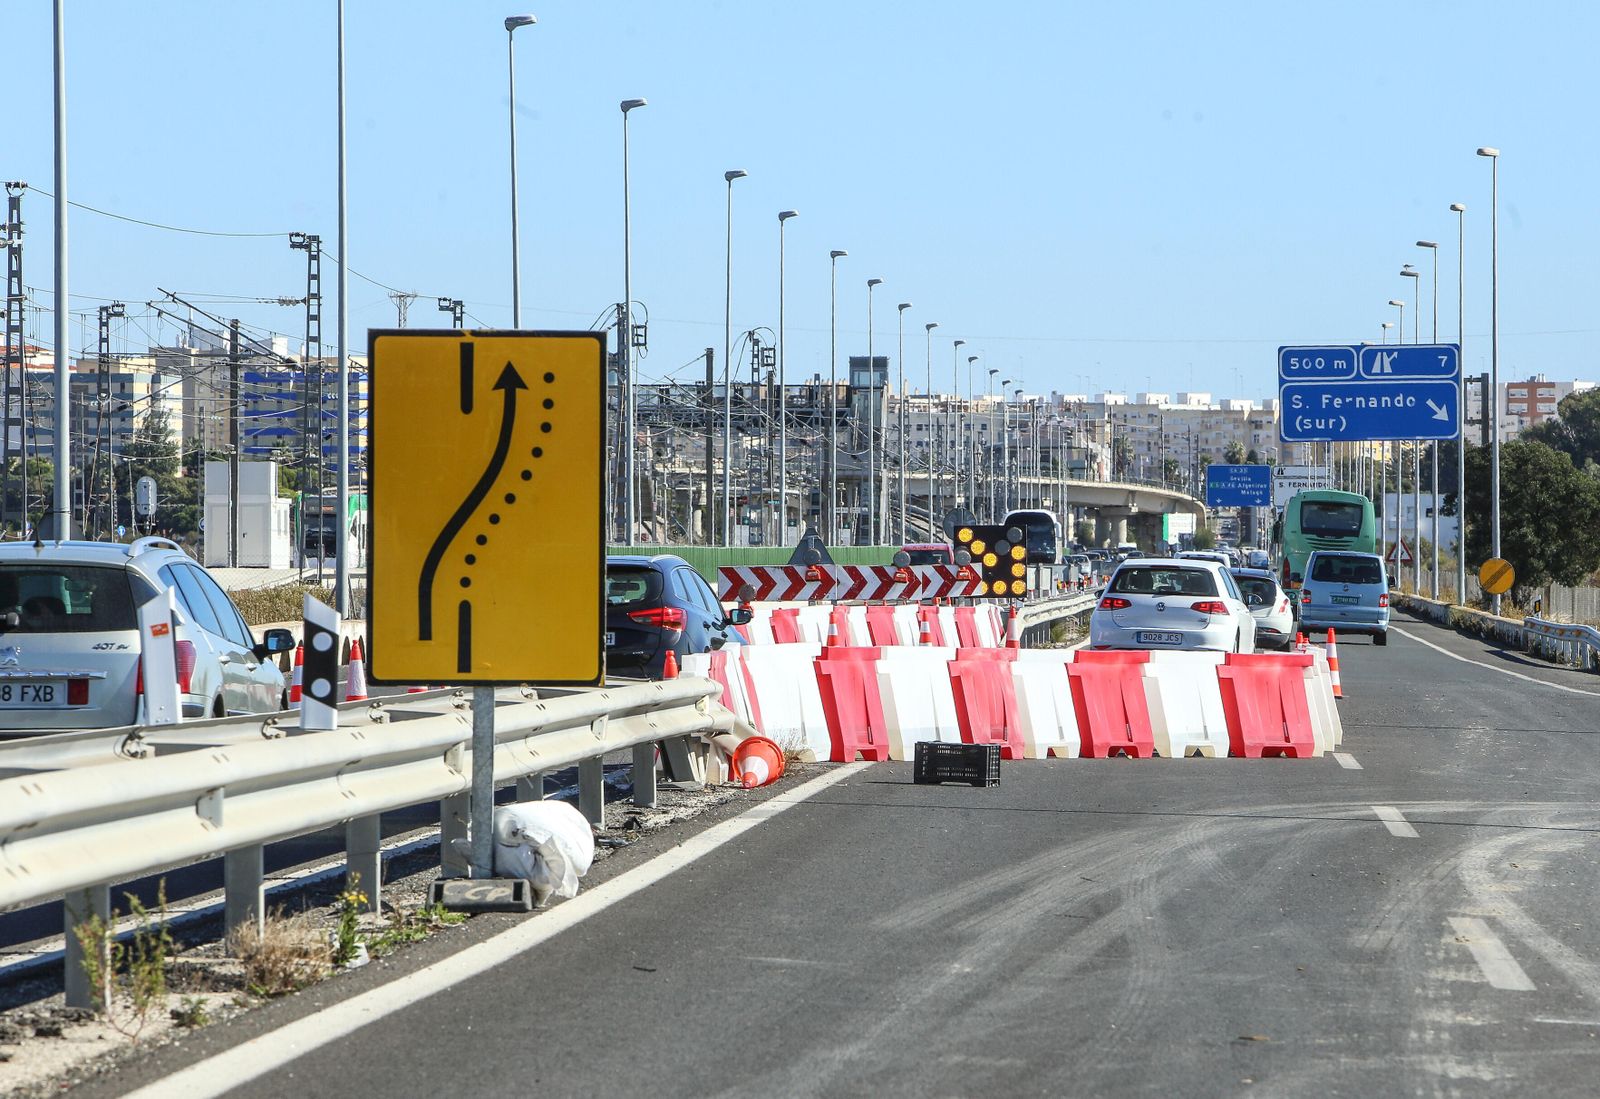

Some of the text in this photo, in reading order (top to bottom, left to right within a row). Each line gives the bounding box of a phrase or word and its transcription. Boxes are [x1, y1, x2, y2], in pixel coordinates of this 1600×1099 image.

[1290, 357, 1347, 370] 500 m
[1437, 355, 1448, 368] 7
[1291, 393, 1416, 409] S. Fernando
[1295, 415, 1347, 432] (sur)
[1143, 633, 1179, 642] 9028 JCS
[0, 685, 54, 702] 8 FXB
